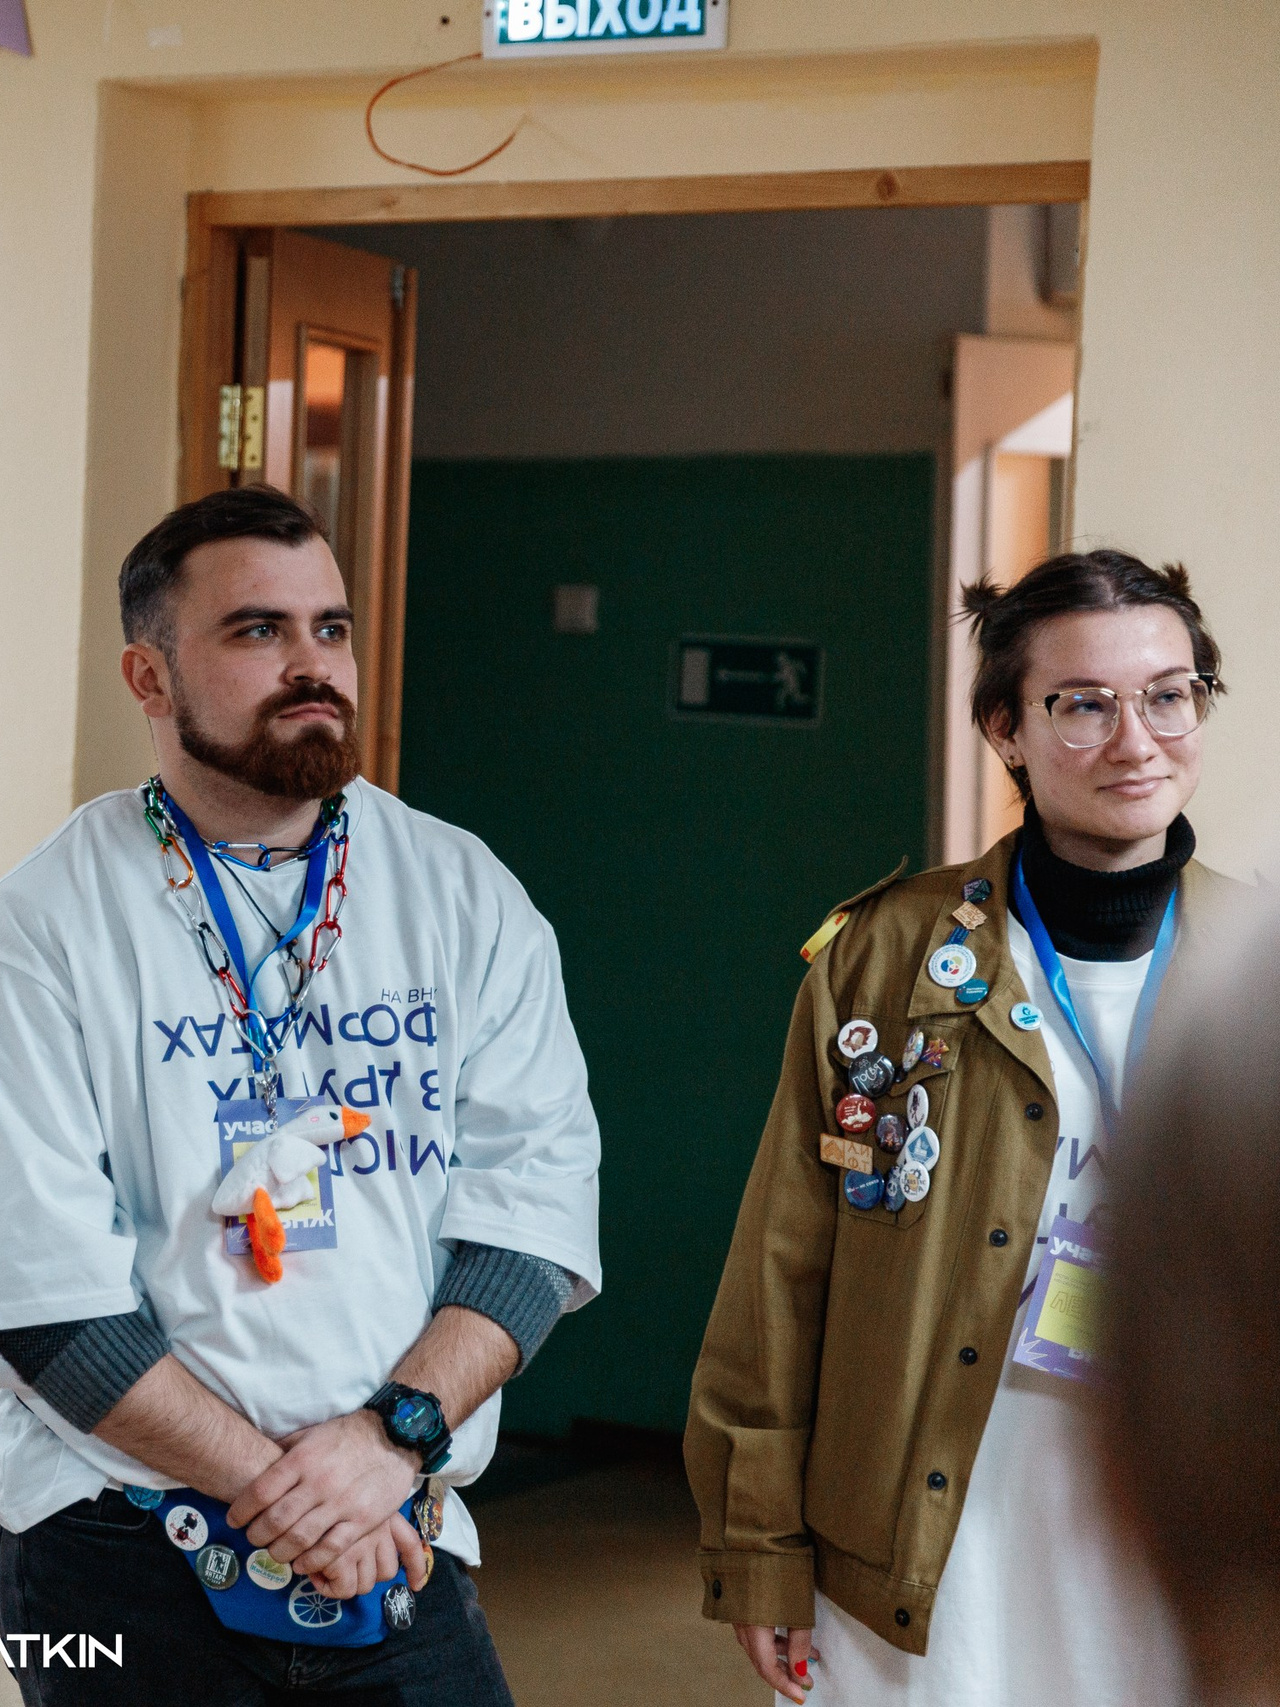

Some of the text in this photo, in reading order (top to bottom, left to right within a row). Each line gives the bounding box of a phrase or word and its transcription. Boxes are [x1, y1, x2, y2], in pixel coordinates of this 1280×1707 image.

[507, 0, 701, 41] ВЫХОД
[381, 987, 438, 1003] НА ВН
[1049, 1236, 1102, 1261] уча
